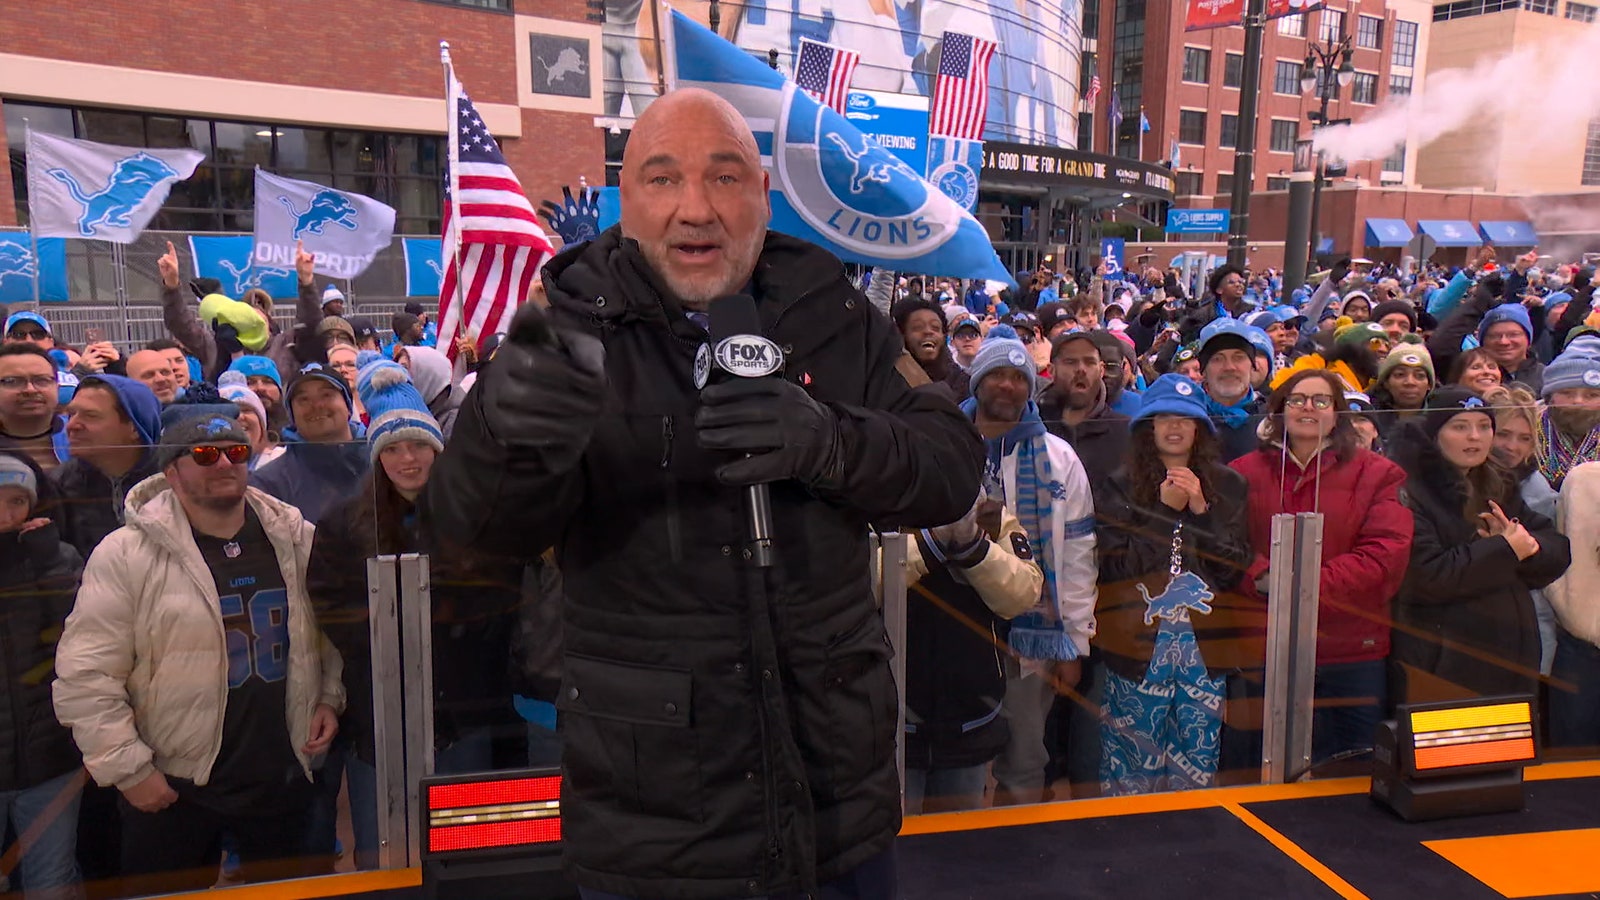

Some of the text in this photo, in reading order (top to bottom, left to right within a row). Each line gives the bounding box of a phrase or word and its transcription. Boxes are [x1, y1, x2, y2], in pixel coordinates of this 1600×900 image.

[989, 152, 996, 169] A
[998, 152, 1019, 170] GOOD
[1022, 154, 1039, 172] TIME
[1041, 156, 1055, 174] FOR
[1057, 158, 1062, 174] A
[1064, 160, 1094, 178] GRAND
[1094, 162, 1106, 179] TIME
[827, 209, 931, 245] LIONS
[729, 343, 768, 362] FOX
[730, 360, 769, 368] SPORTS
[220, 587, 288, 690] 58
[1166, 742, 1212, 787] LIONS
